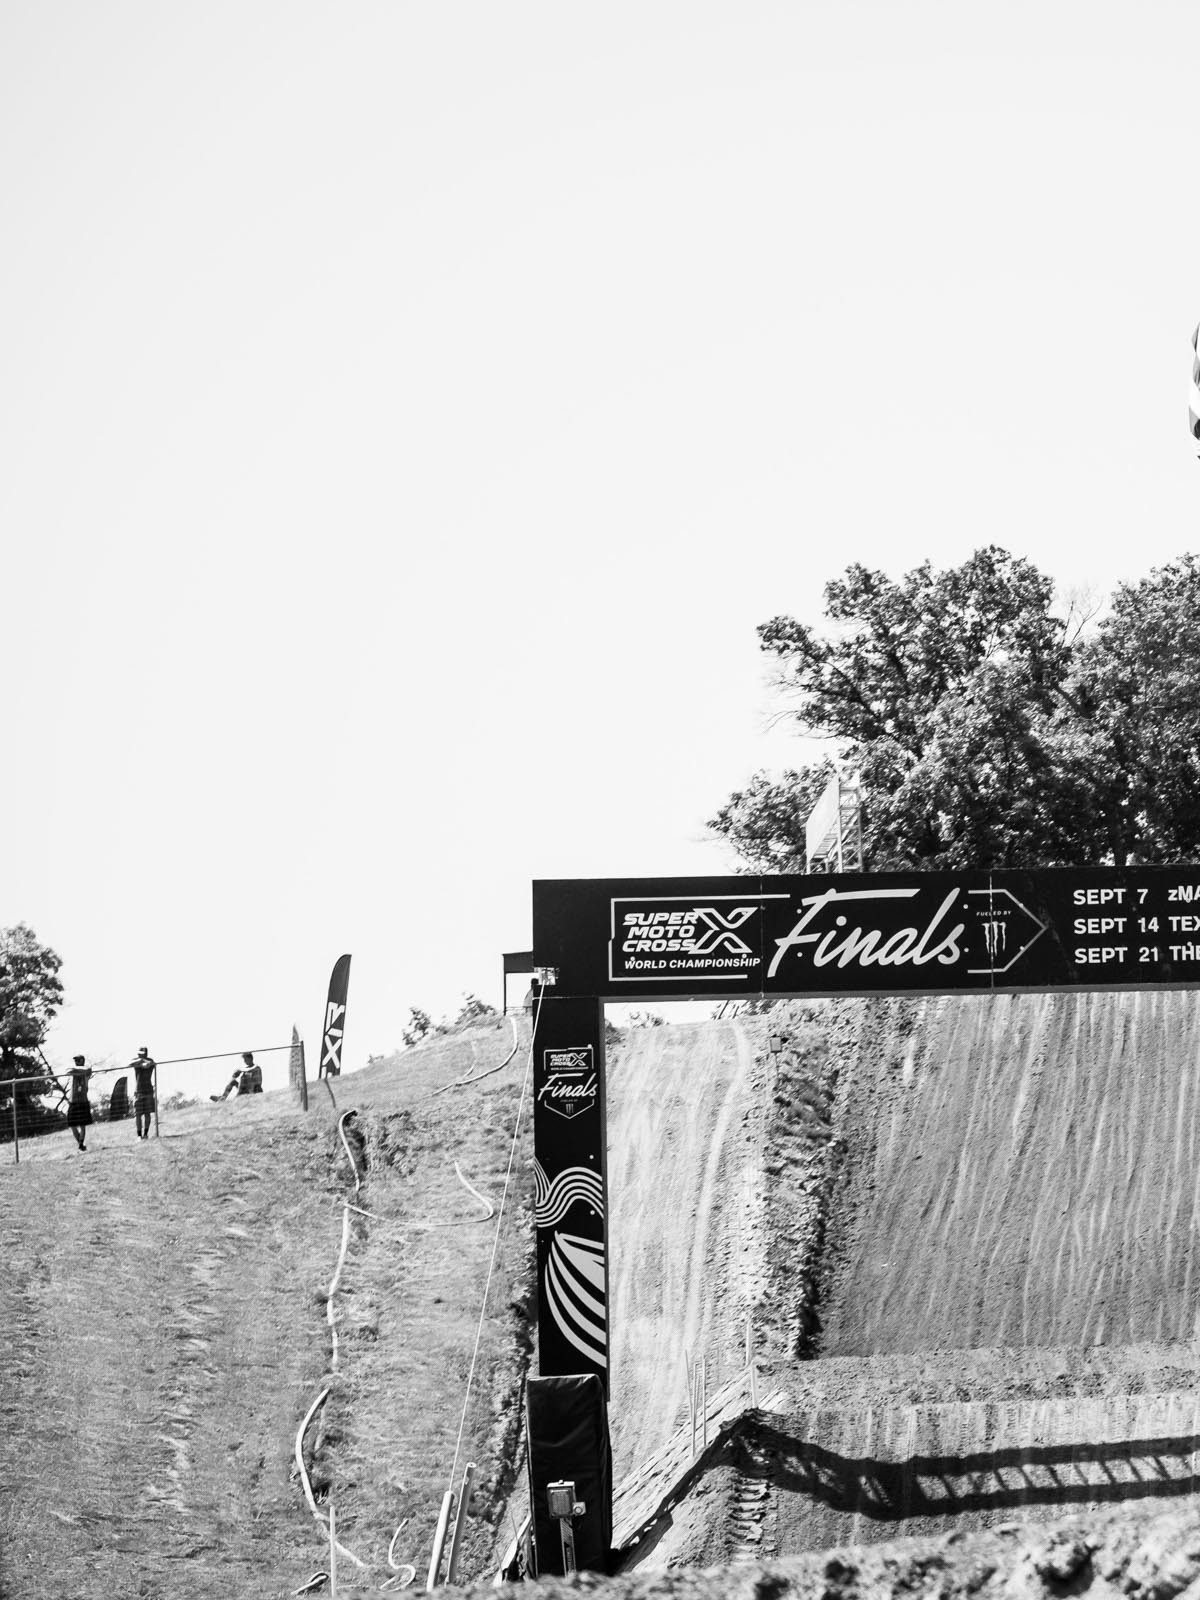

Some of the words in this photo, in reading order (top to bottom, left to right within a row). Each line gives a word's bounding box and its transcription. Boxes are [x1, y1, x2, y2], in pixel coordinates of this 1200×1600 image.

[1073, 888, 1127, 905] SEPT
[1137, 888, 1149, 904] 7
[622, 911, 700, 926] SUPER
[1073, 918, 1127, 934] SEPT
[1138, 917, 1159, 933] 14
[627, 925, 695, 939] MOTO
[767, 888, 965, 978] Finals
[622, 939, 697, 952] CROSS
[624, 960, 667, 969] WORLD
[669, 957, 761, 968] CHAMPIONSHIP
[1074, 947, 1128, 964] SEPT
[1138, 946, 1159, 962] 21
[537, 1073, 598, 1101] Finals
